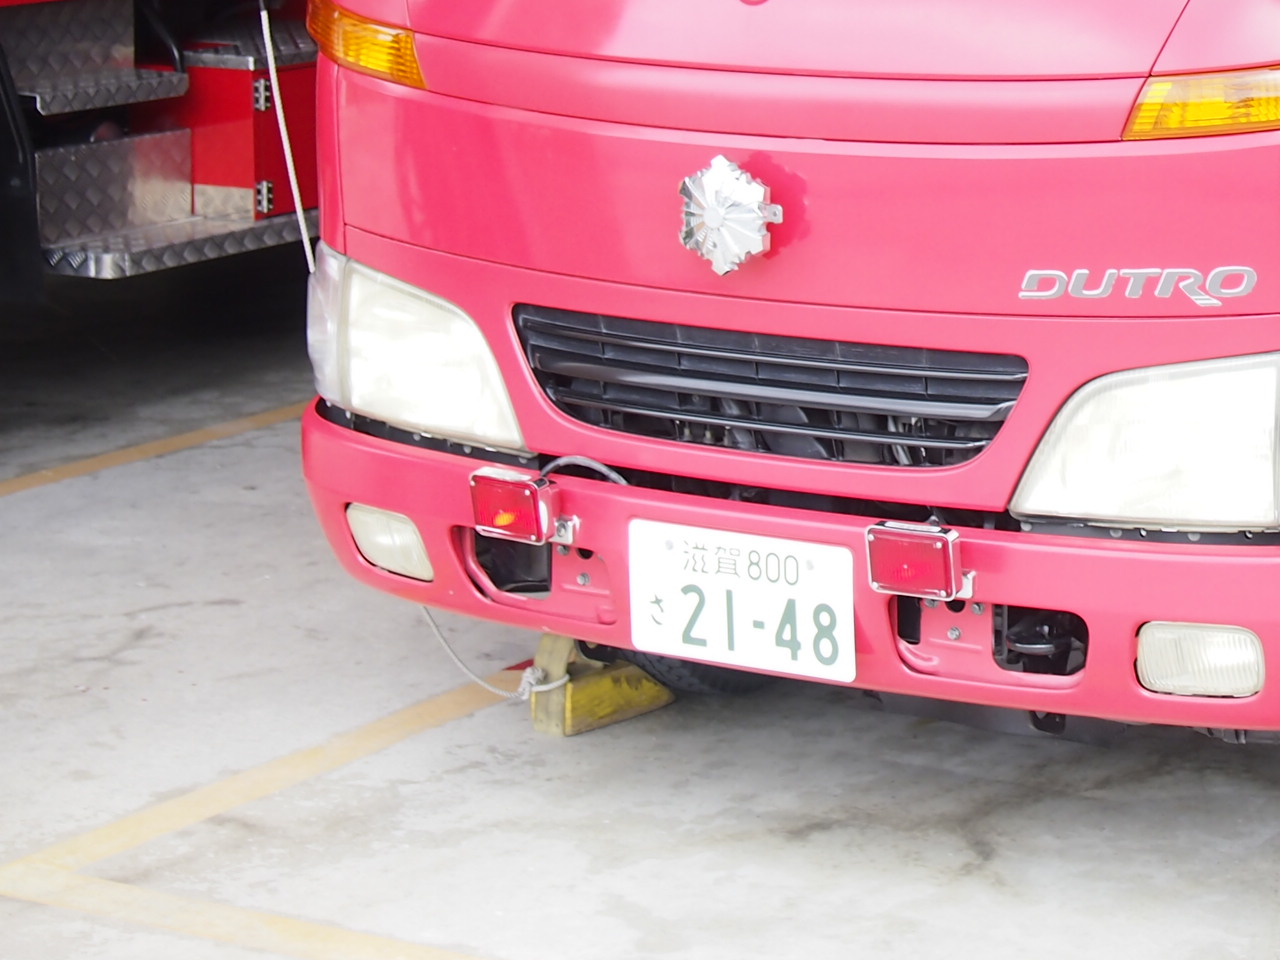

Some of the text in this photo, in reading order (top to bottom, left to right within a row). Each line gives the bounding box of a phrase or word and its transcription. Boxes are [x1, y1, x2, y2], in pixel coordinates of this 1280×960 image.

[1018, 266, 1258, 306] DUTRO
[650, 583, 840, 666] さ 21-48
